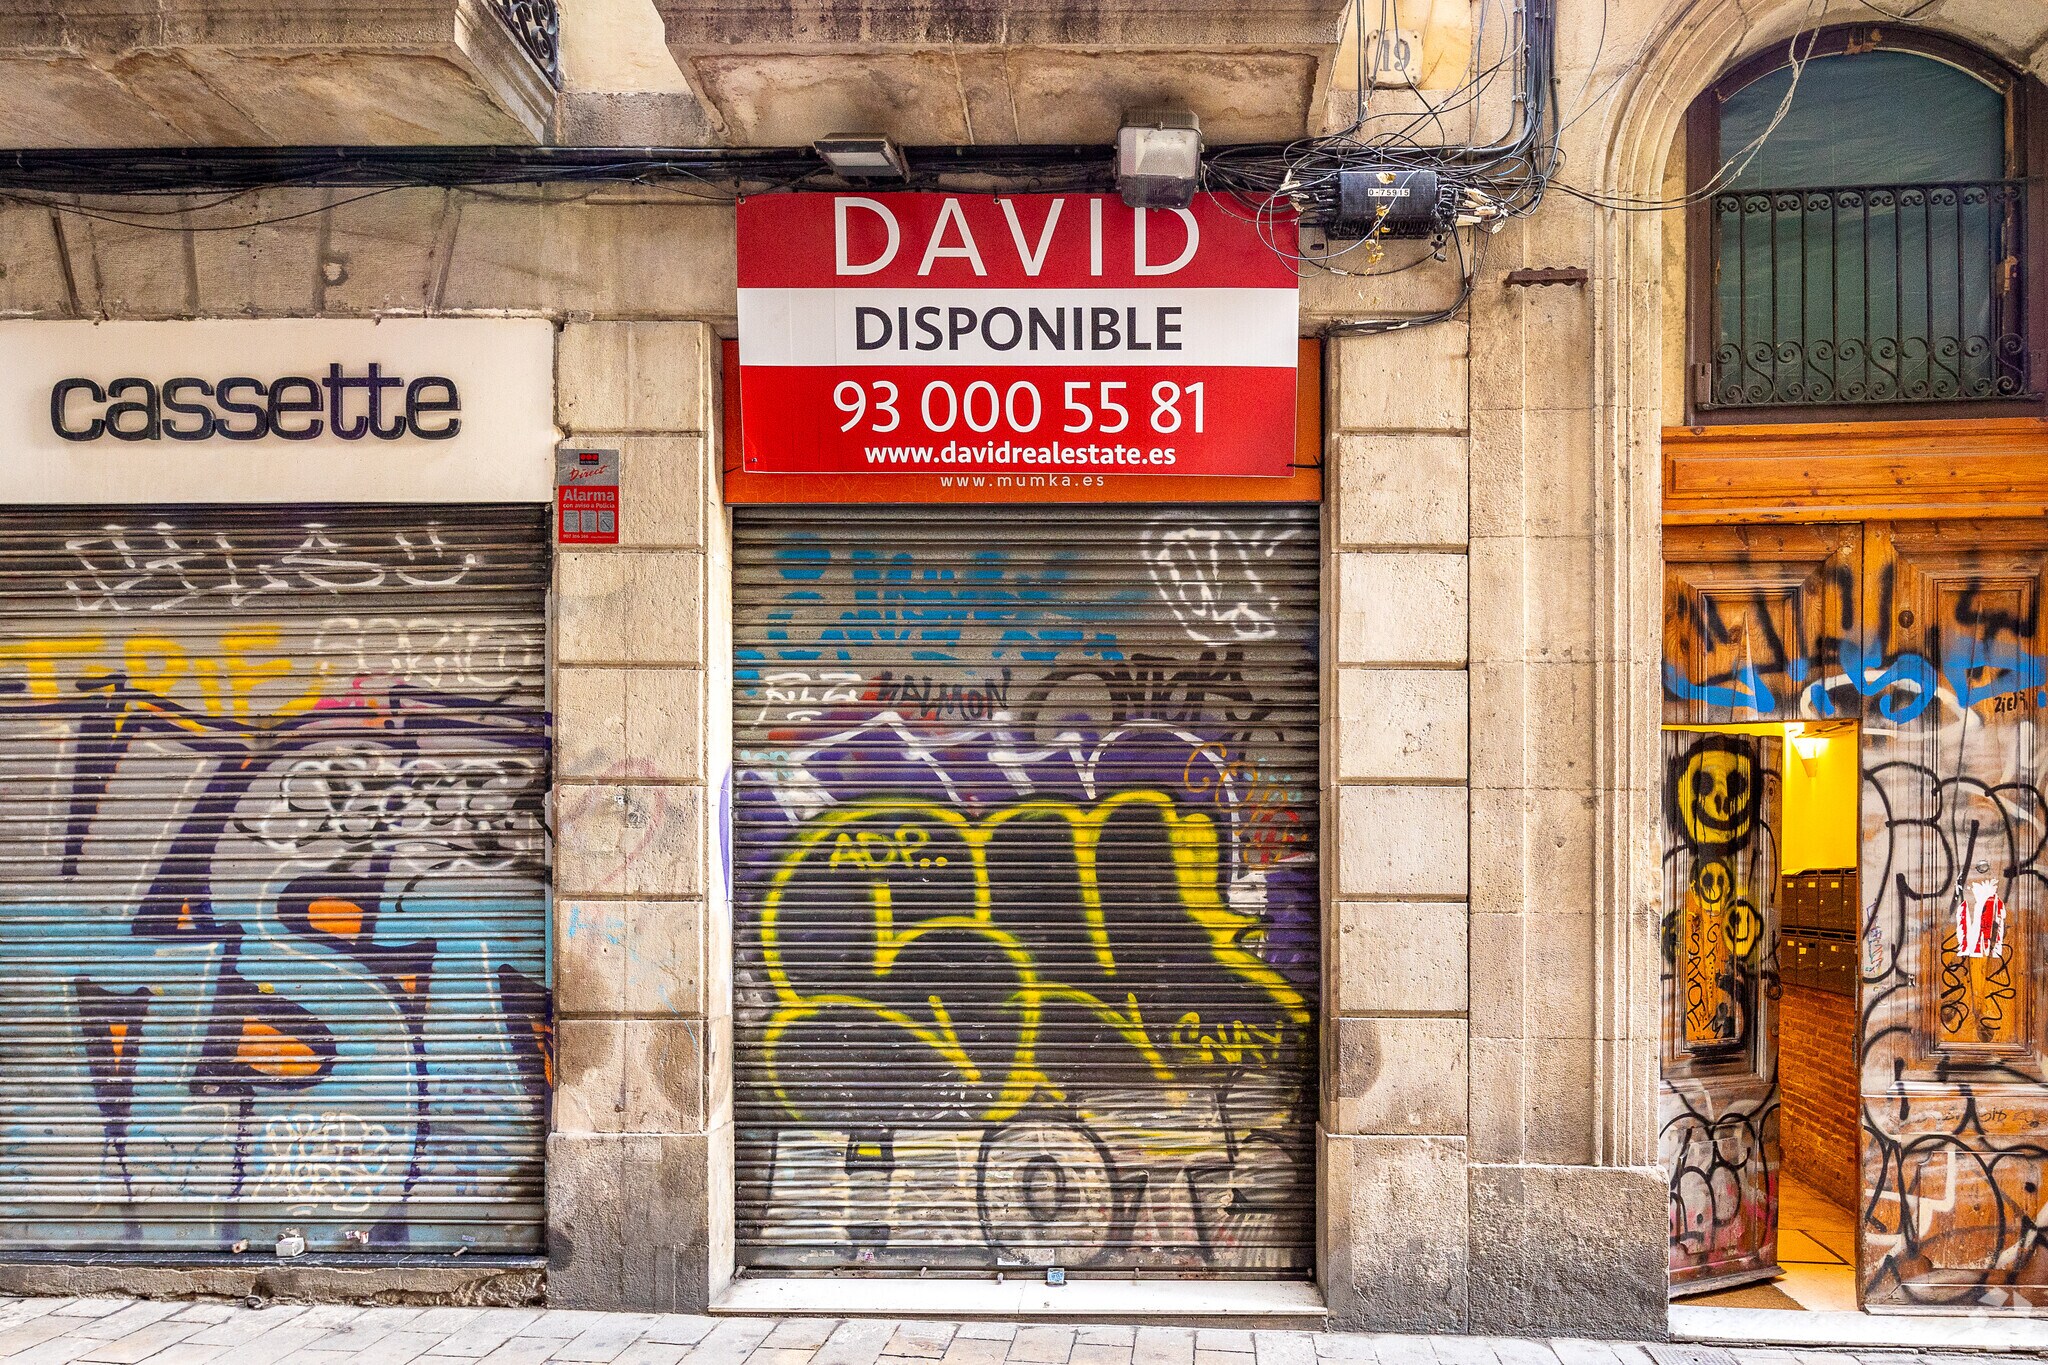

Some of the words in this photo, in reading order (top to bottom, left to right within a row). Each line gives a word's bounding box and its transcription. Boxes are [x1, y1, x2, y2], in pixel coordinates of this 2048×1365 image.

[1379, 38, 1411, 72] 19
[835, 196, 1200, 276] DAVID
[856, 306, 1183, 352] DISPONIBLE
[51, 362, 462, 442] cassette
[833, 380, 899, 433] 93
[921, 380, 1042, 433] 000
[1063, 381, 1129, 434] 55
[1150, 380, 1204, 434] 81
[864, 441, 1176, 465] www.davidrealestate.es
[569, 465, 608, 481] Direct
[940, 475, 1105, 487] www.mumka.es
[563, 488, 615, 502] Alarma
